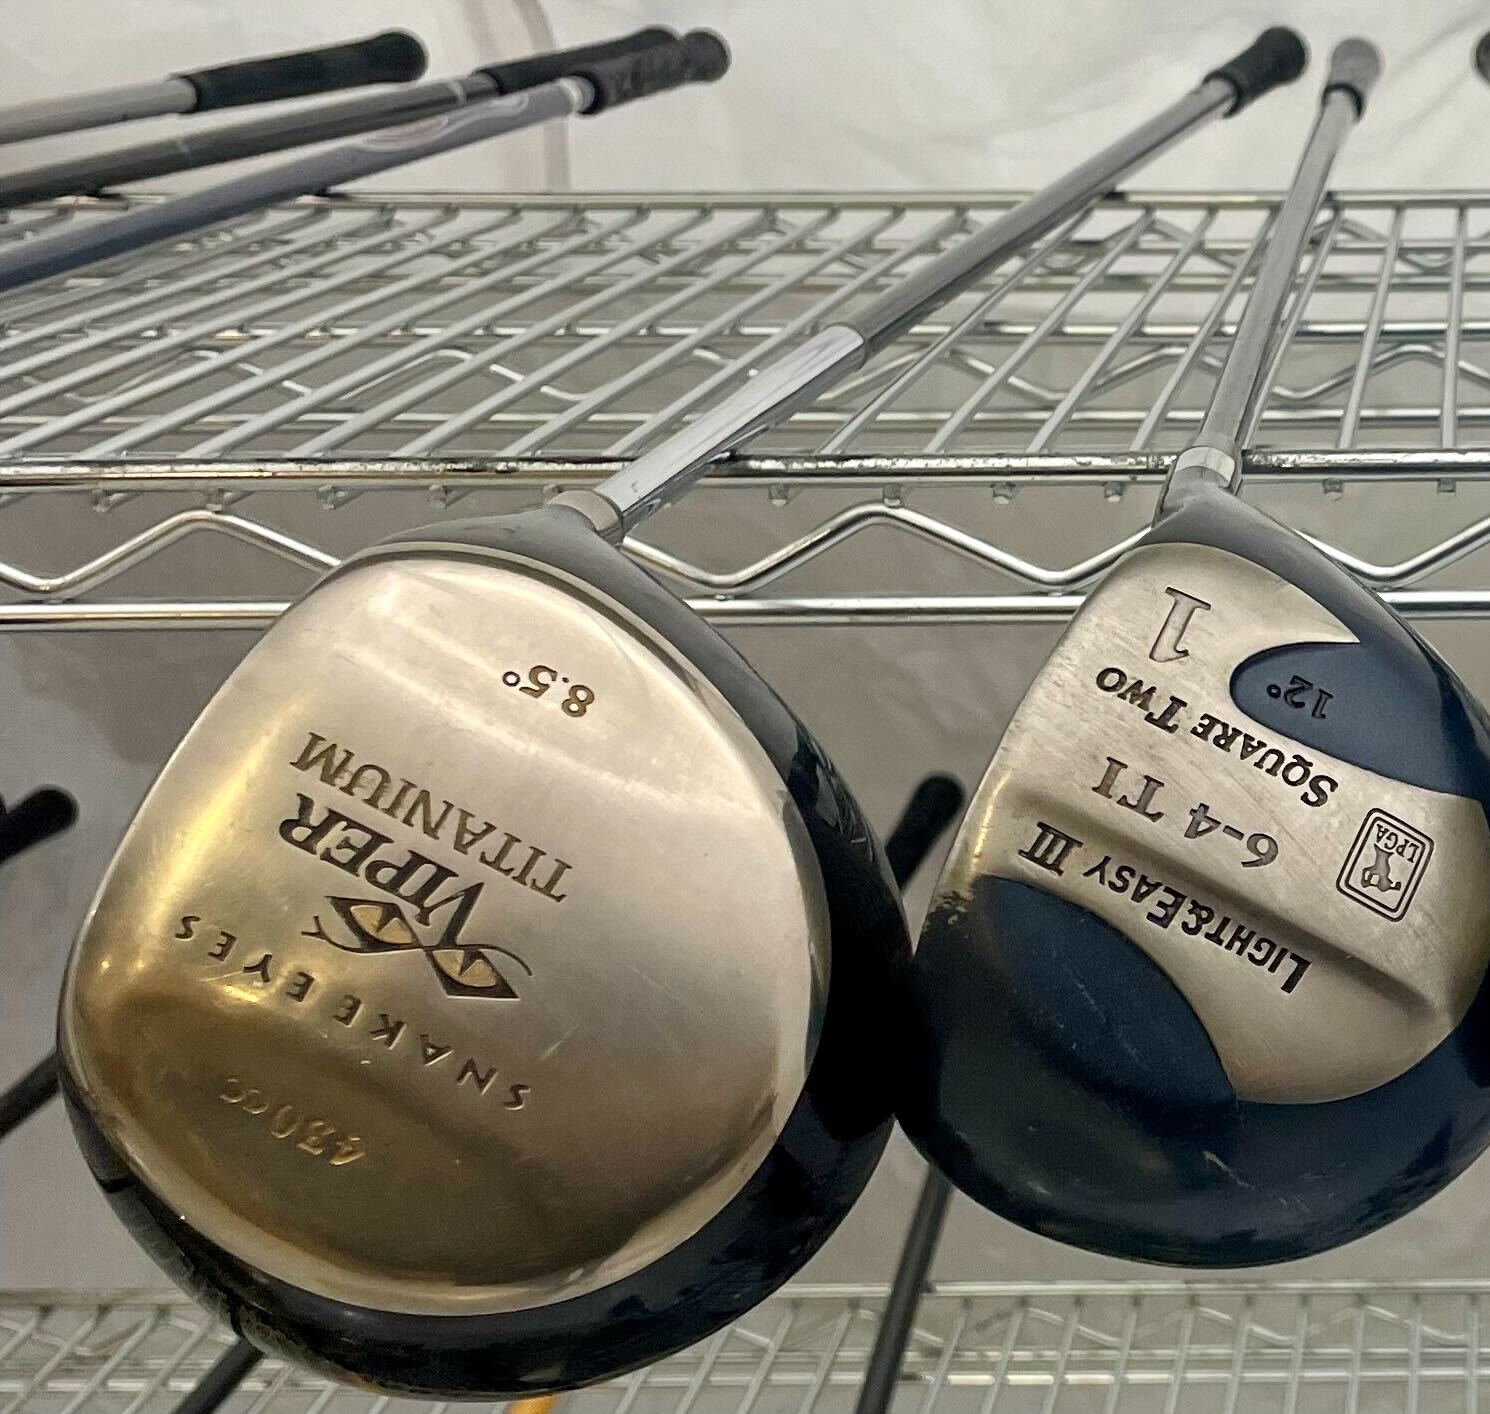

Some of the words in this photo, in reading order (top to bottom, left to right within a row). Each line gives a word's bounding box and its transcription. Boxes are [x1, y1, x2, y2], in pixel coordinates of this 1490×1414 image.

[1148, 587, 1210, 663] 1
[502, 664, 595, 718] 8.5°
[1266, 675, 1334, 719] 12°
[291, 731, 574, 902] TITANIUM
[1017, 821, 1083, 876] III
[1183, 802, 1280, 869] 6-4
[1373, 824, 1423, 863] LPGA
[278, 793, 490, 950] VIPER
[175, 914, 314, 1004] EYES
[334, 994, 530, 1111] SNAKE
